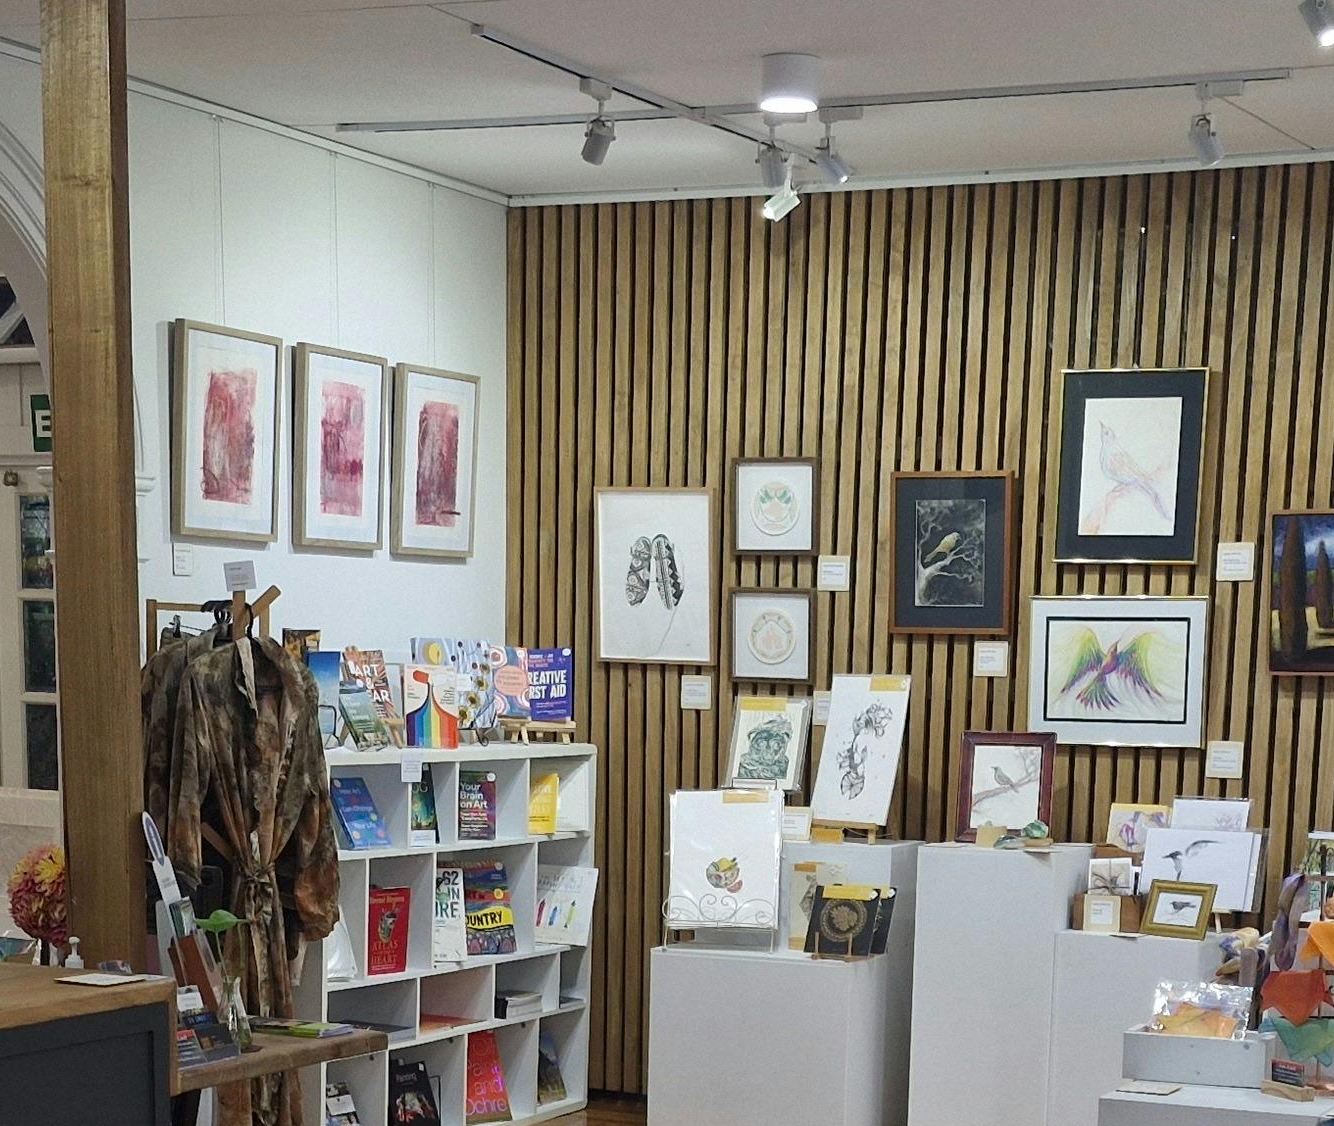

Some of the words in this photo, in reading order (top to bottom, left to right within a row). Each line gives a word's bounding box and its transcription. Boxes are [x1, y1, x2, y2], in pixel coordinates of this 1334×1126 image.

[550, 684, 566, 698] AID
[460, 782, 480, 791] Your
[460, 790, 483, 800] Brain
[474, 800, 488, 808] Art
[475, 1076, 505, 1096] and
